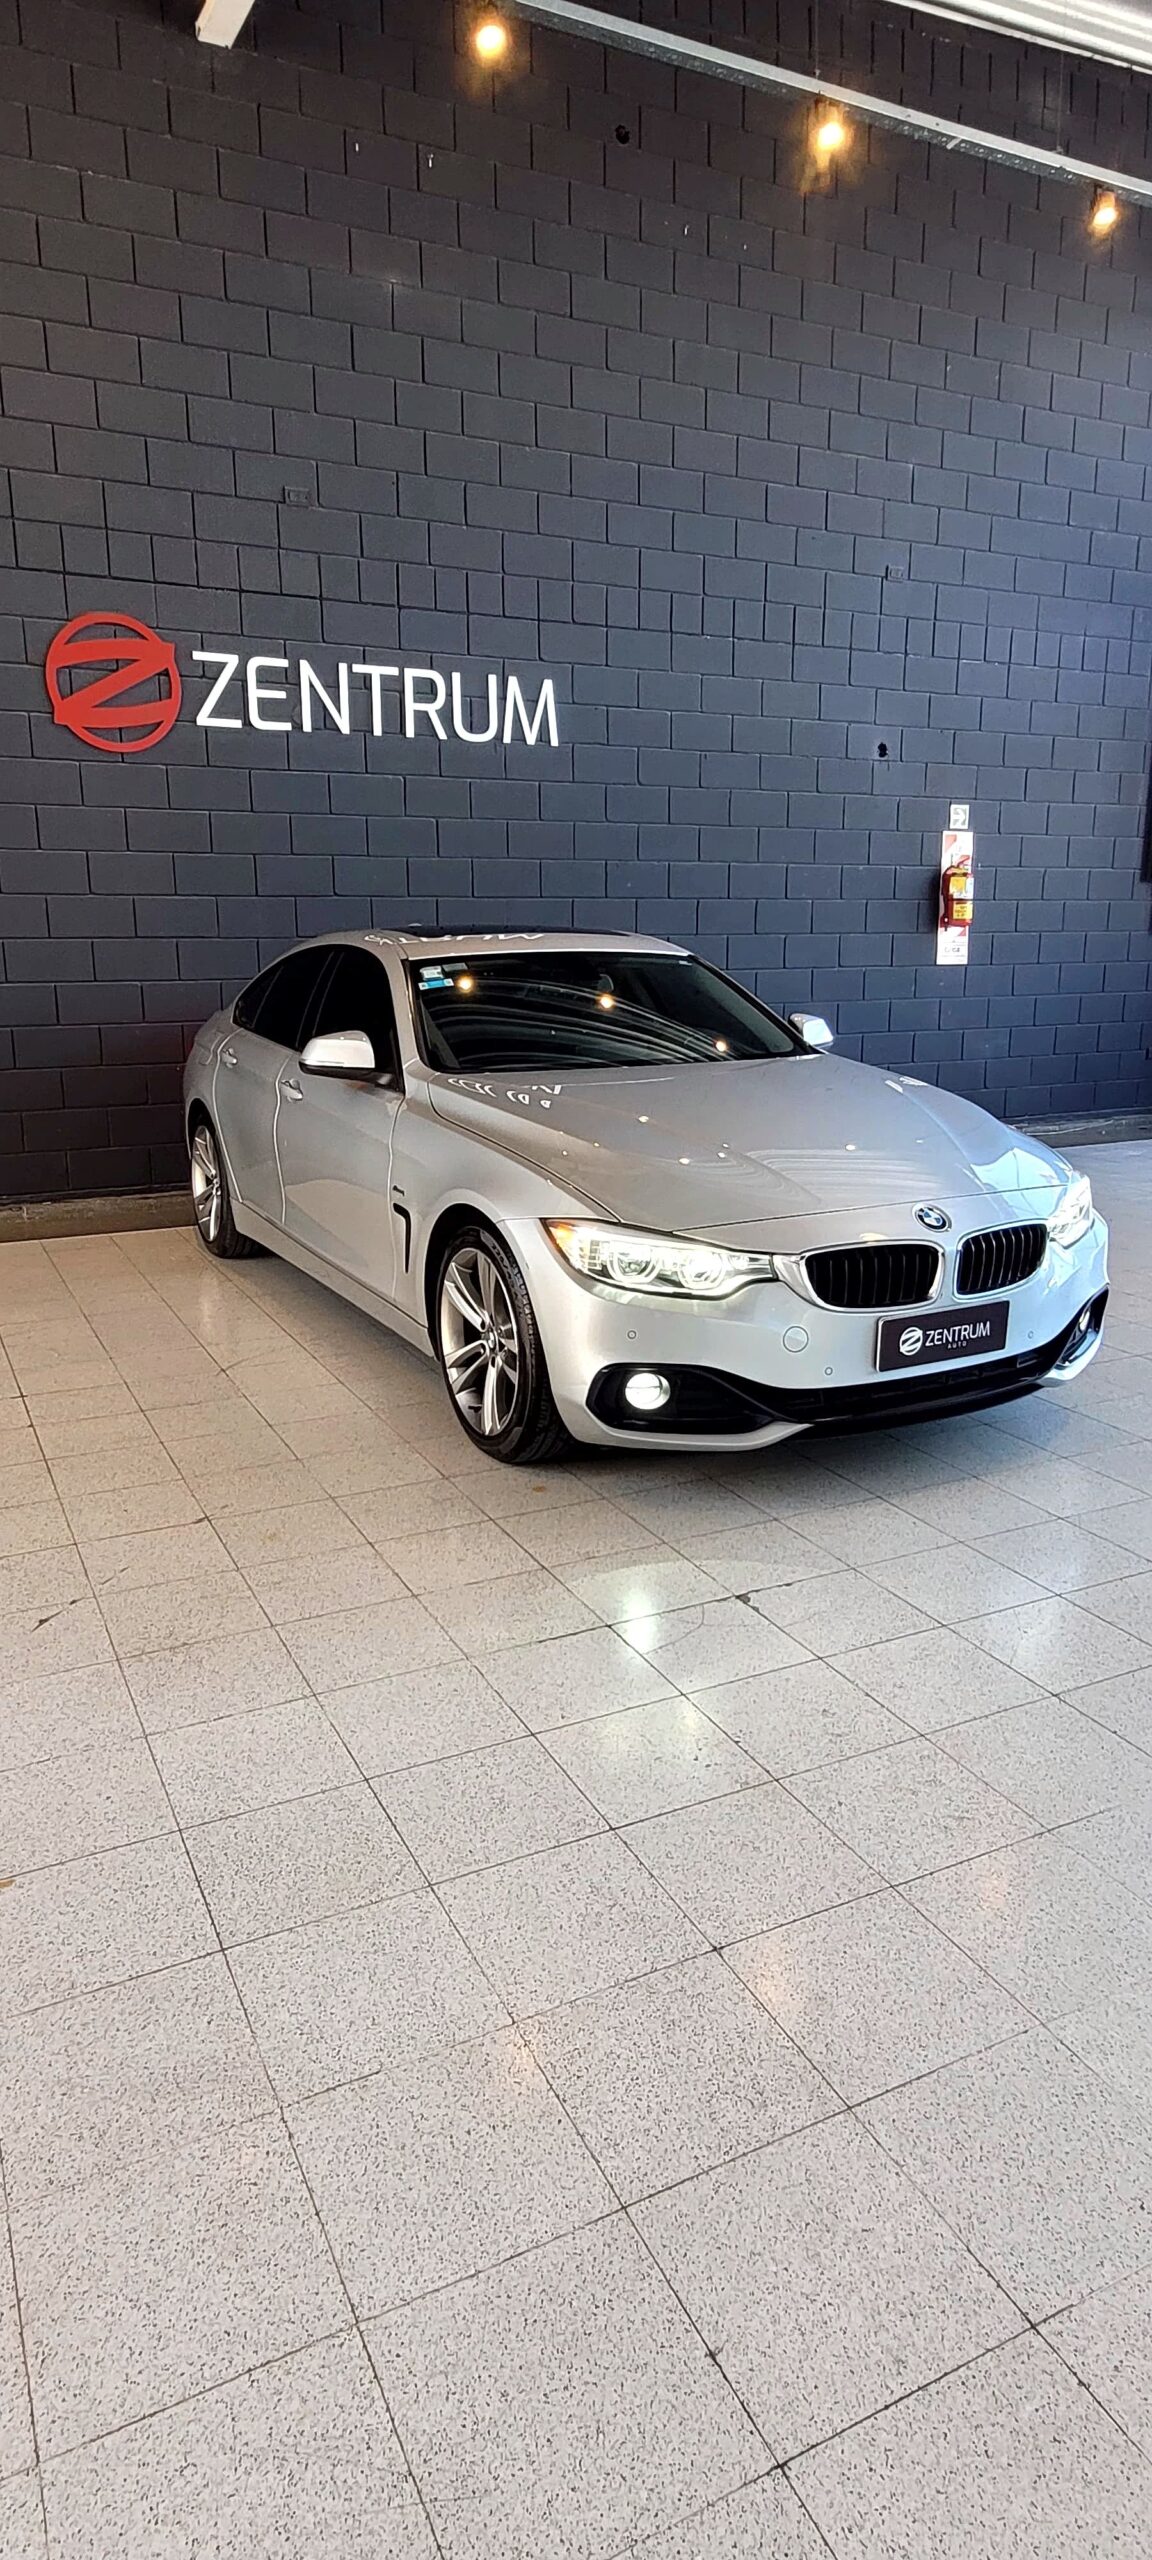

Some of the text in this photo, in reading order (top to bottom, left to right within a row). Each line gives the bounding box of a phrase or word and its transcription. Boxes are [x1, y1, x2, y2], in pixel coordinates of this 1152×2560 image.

[192, 650, 559, 747] ZENTRUM
[925, 1321, 990, 1347] ZENTRUM
[948, 1341, 967, 1349] AUTO
